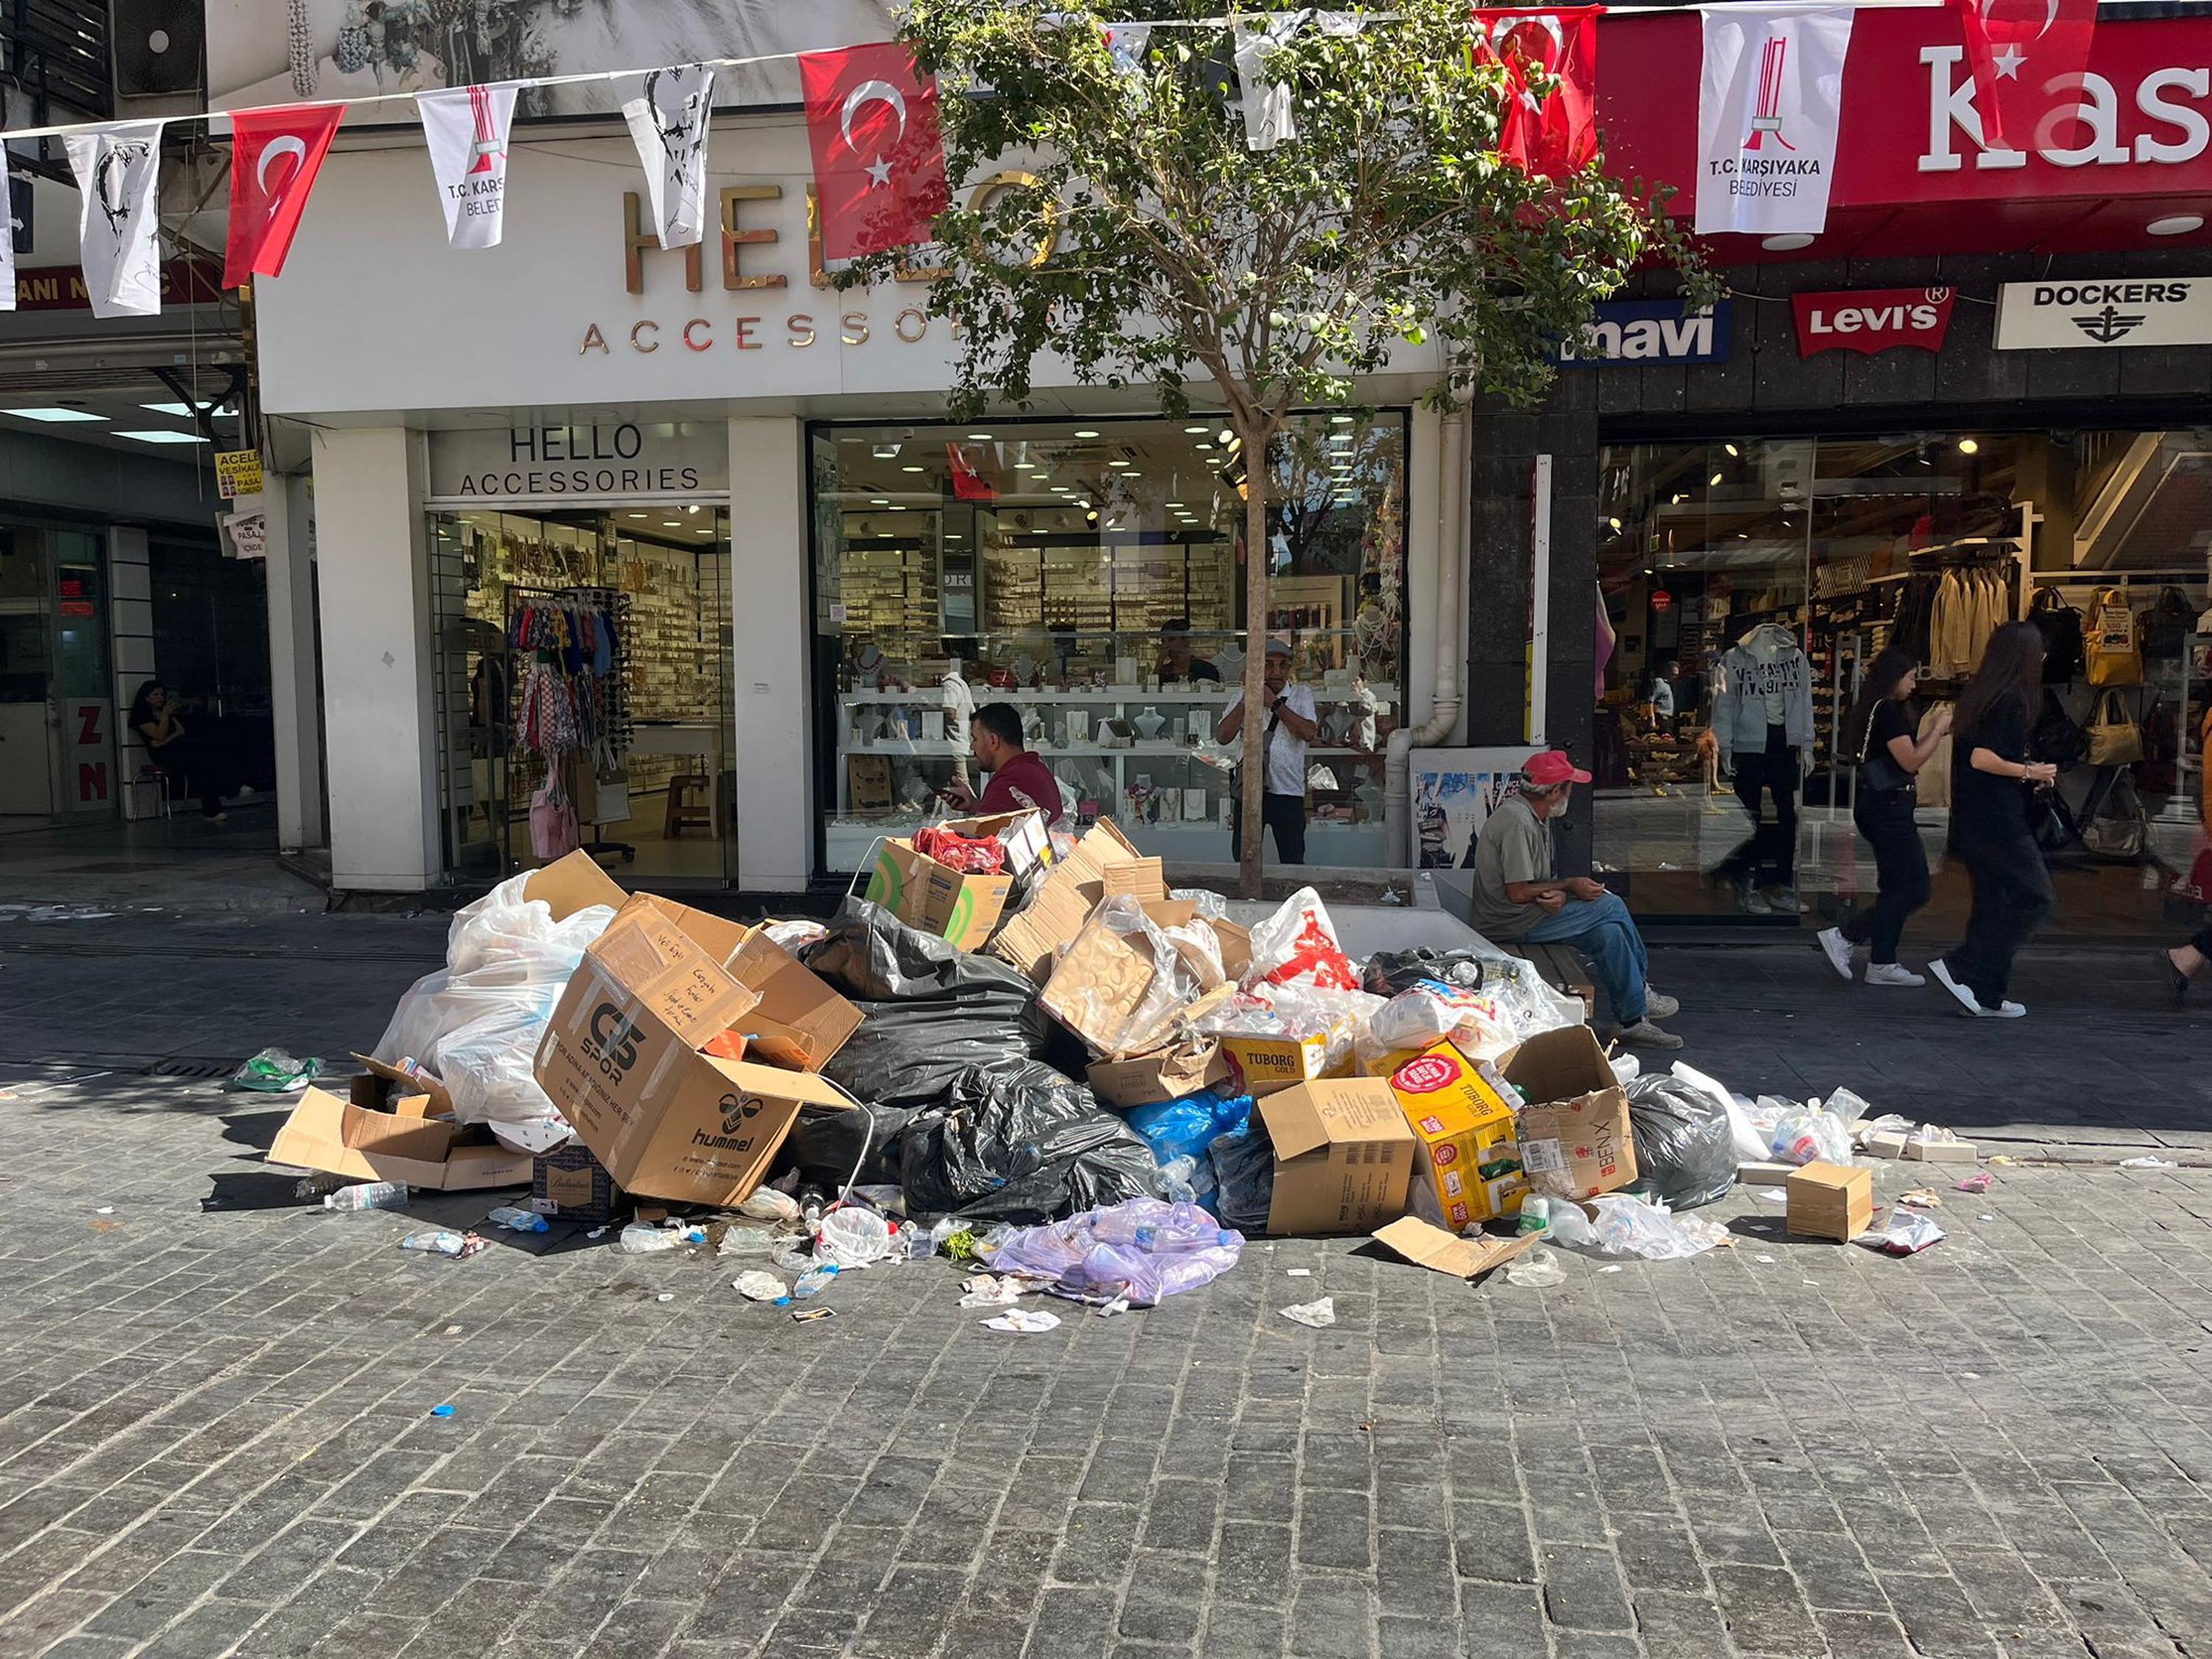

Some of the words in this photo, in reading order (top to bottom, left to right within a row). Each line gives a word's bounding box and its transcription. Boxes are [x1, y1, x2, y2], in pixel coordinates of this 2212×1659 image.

[1918, 45, 2211, 172] Kas
[1710, 159, 1738, 175] T.C.
[1742, 158, 1820, 177] KARŞIYAKA
[448, 184, 470, 198] T.C.
[1730, 178, 1798, 197] BELEDİYESİ
[2034, 283, 2191, 306] DOCKERS
[510, 424, 642, 462] HELLO
[460, 468, 698, 495] ACCESSORIES
[580, 1037, 622, 1087] SPOR
[1247, 1052, 1295, 1066] TUBORG
[1275, 1066, 1295, 1074] GOLD
[1460, 1084, 1494, 1117] TUBORG
[692, 1127, 754, 1152] hummel
